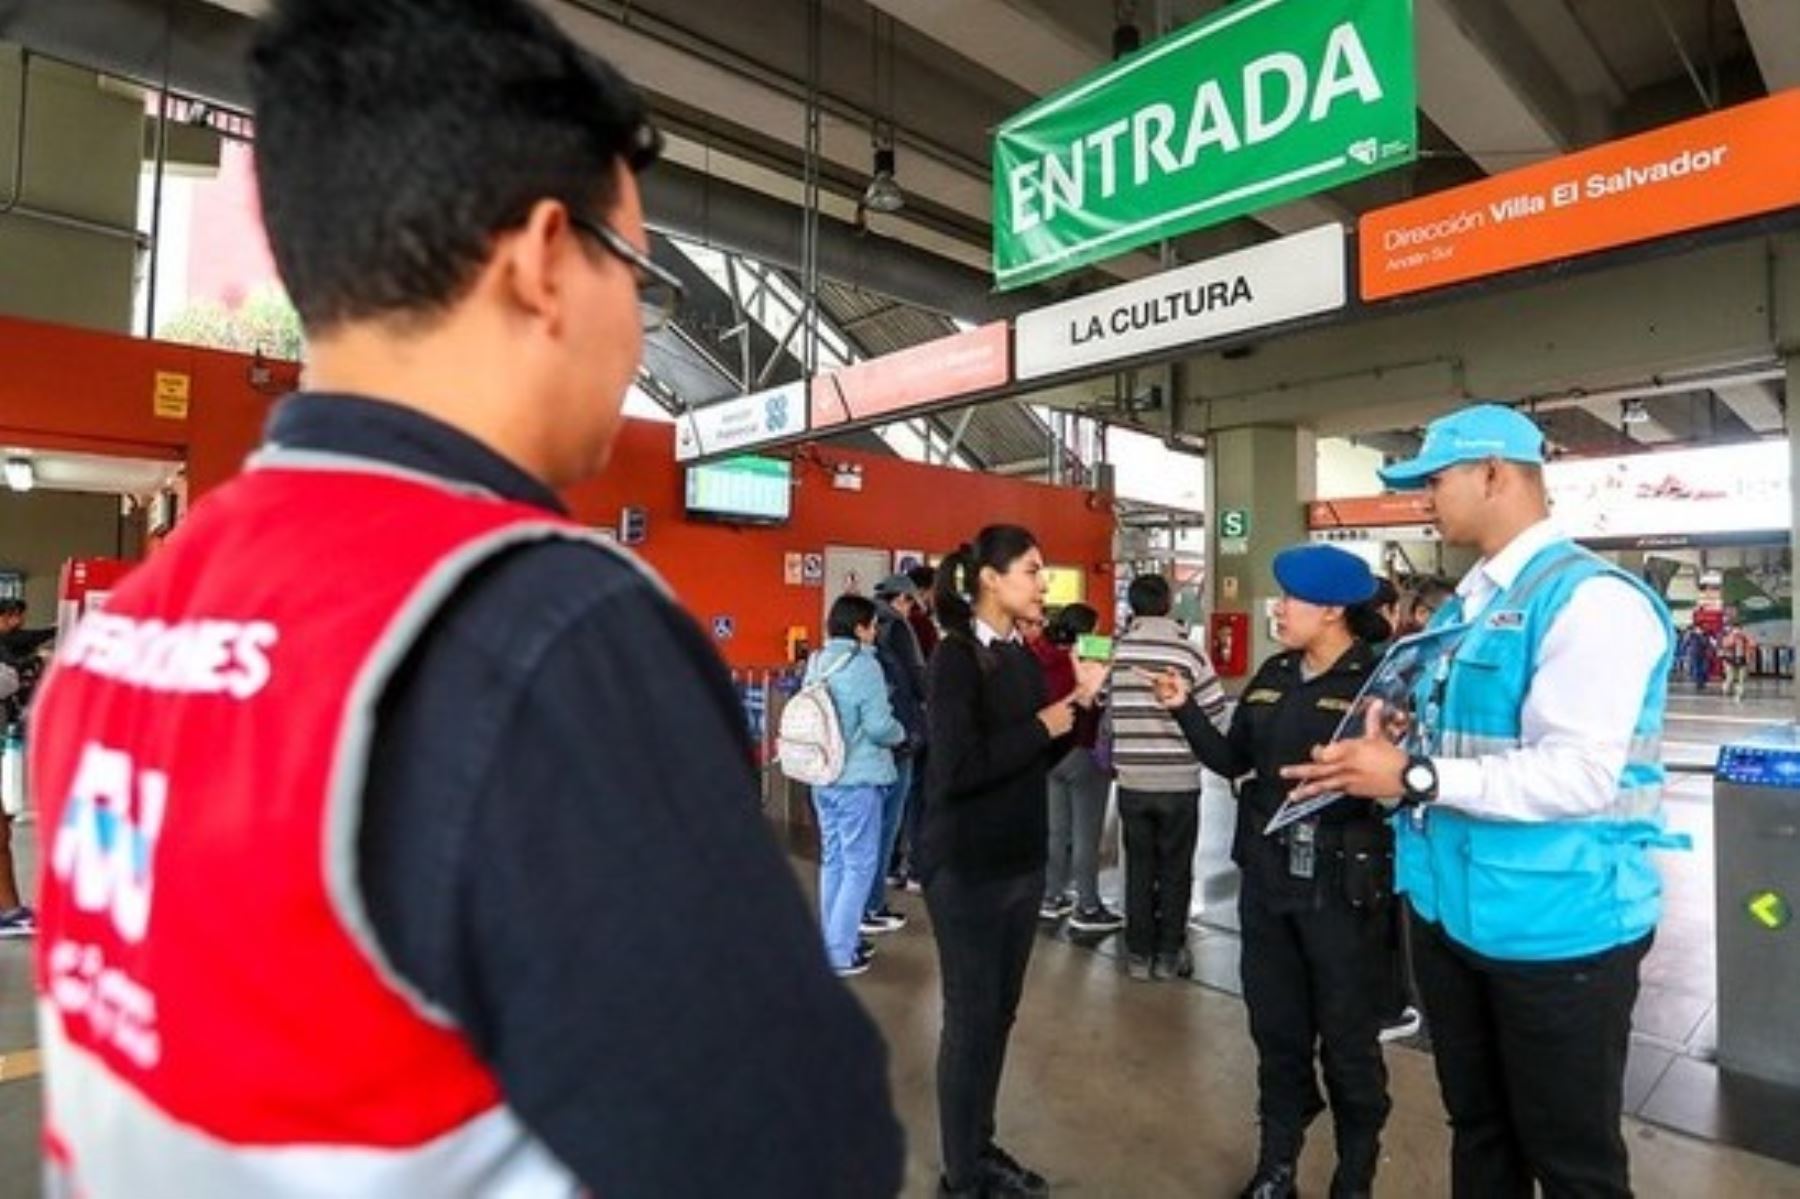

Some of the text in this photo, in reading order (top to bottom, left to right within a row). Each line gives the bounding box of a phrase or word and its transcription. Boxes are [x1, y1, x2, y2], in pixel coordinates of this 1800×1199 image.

[1009, 21, 1384, 234] ENTRADA
[1384, 144, 1730, 251] Dirección Villa El Salvador
[1070, 275, 1253, 346] LA CULTURA
[1223, 511, 1243, 536] S
